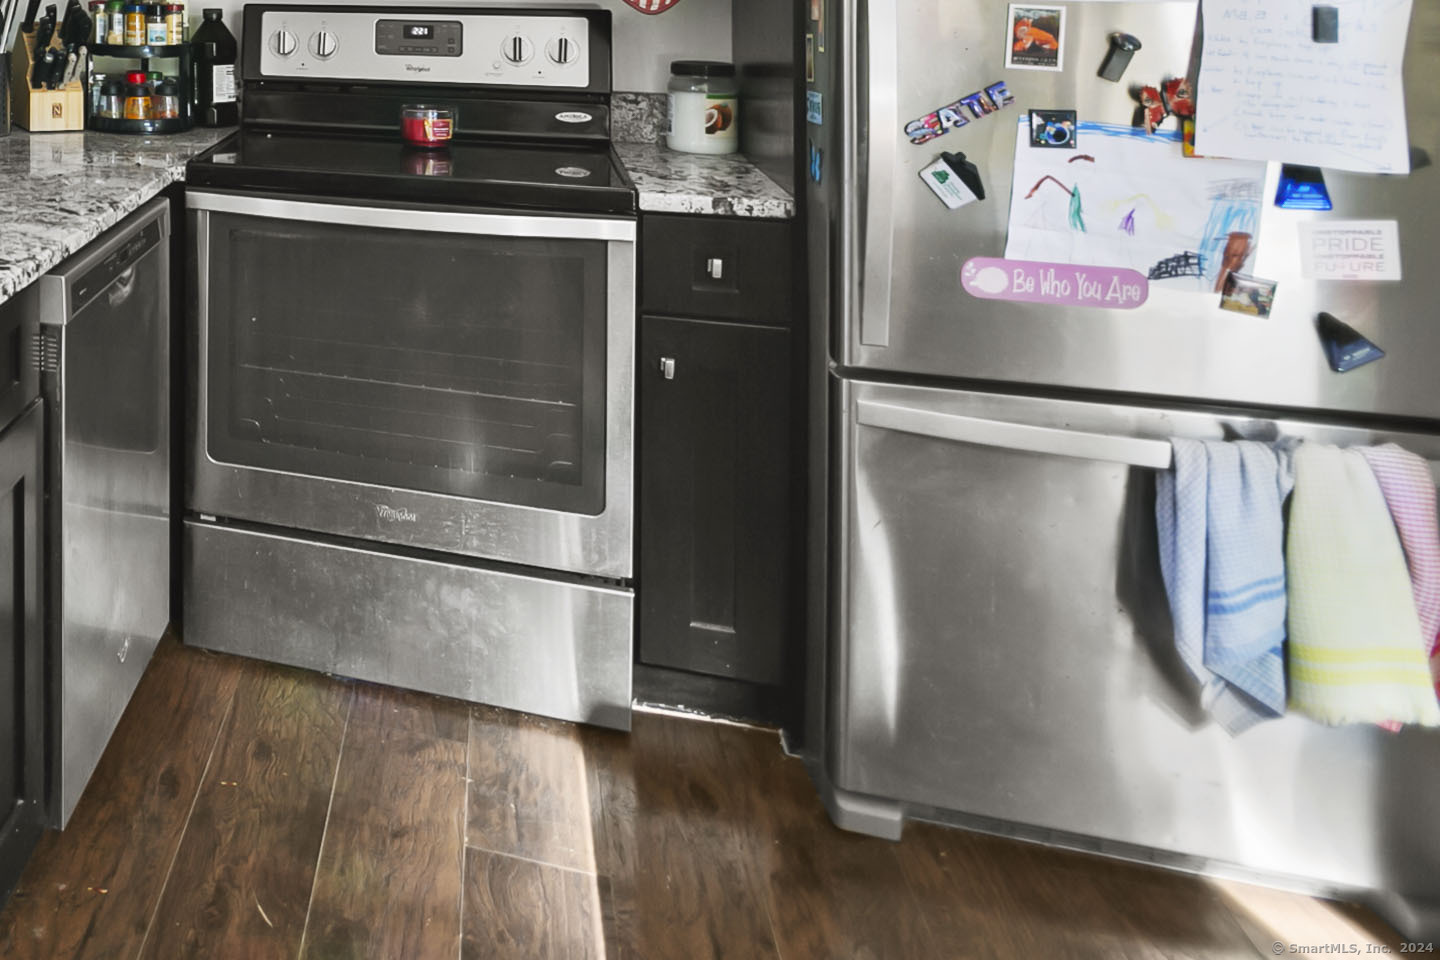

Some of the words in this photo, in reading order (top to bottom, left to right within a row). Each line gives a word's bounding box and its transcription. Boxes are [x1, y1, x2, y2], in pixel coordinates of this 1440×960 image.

[1312, 237, 1384, 252] PRIDE
[1012, 268, 1035, 294] Be
[1039, 268, 1071, 298] Who
[1075, 272, 1102, 301] You
[1105, 275, 1141, 304] Are
